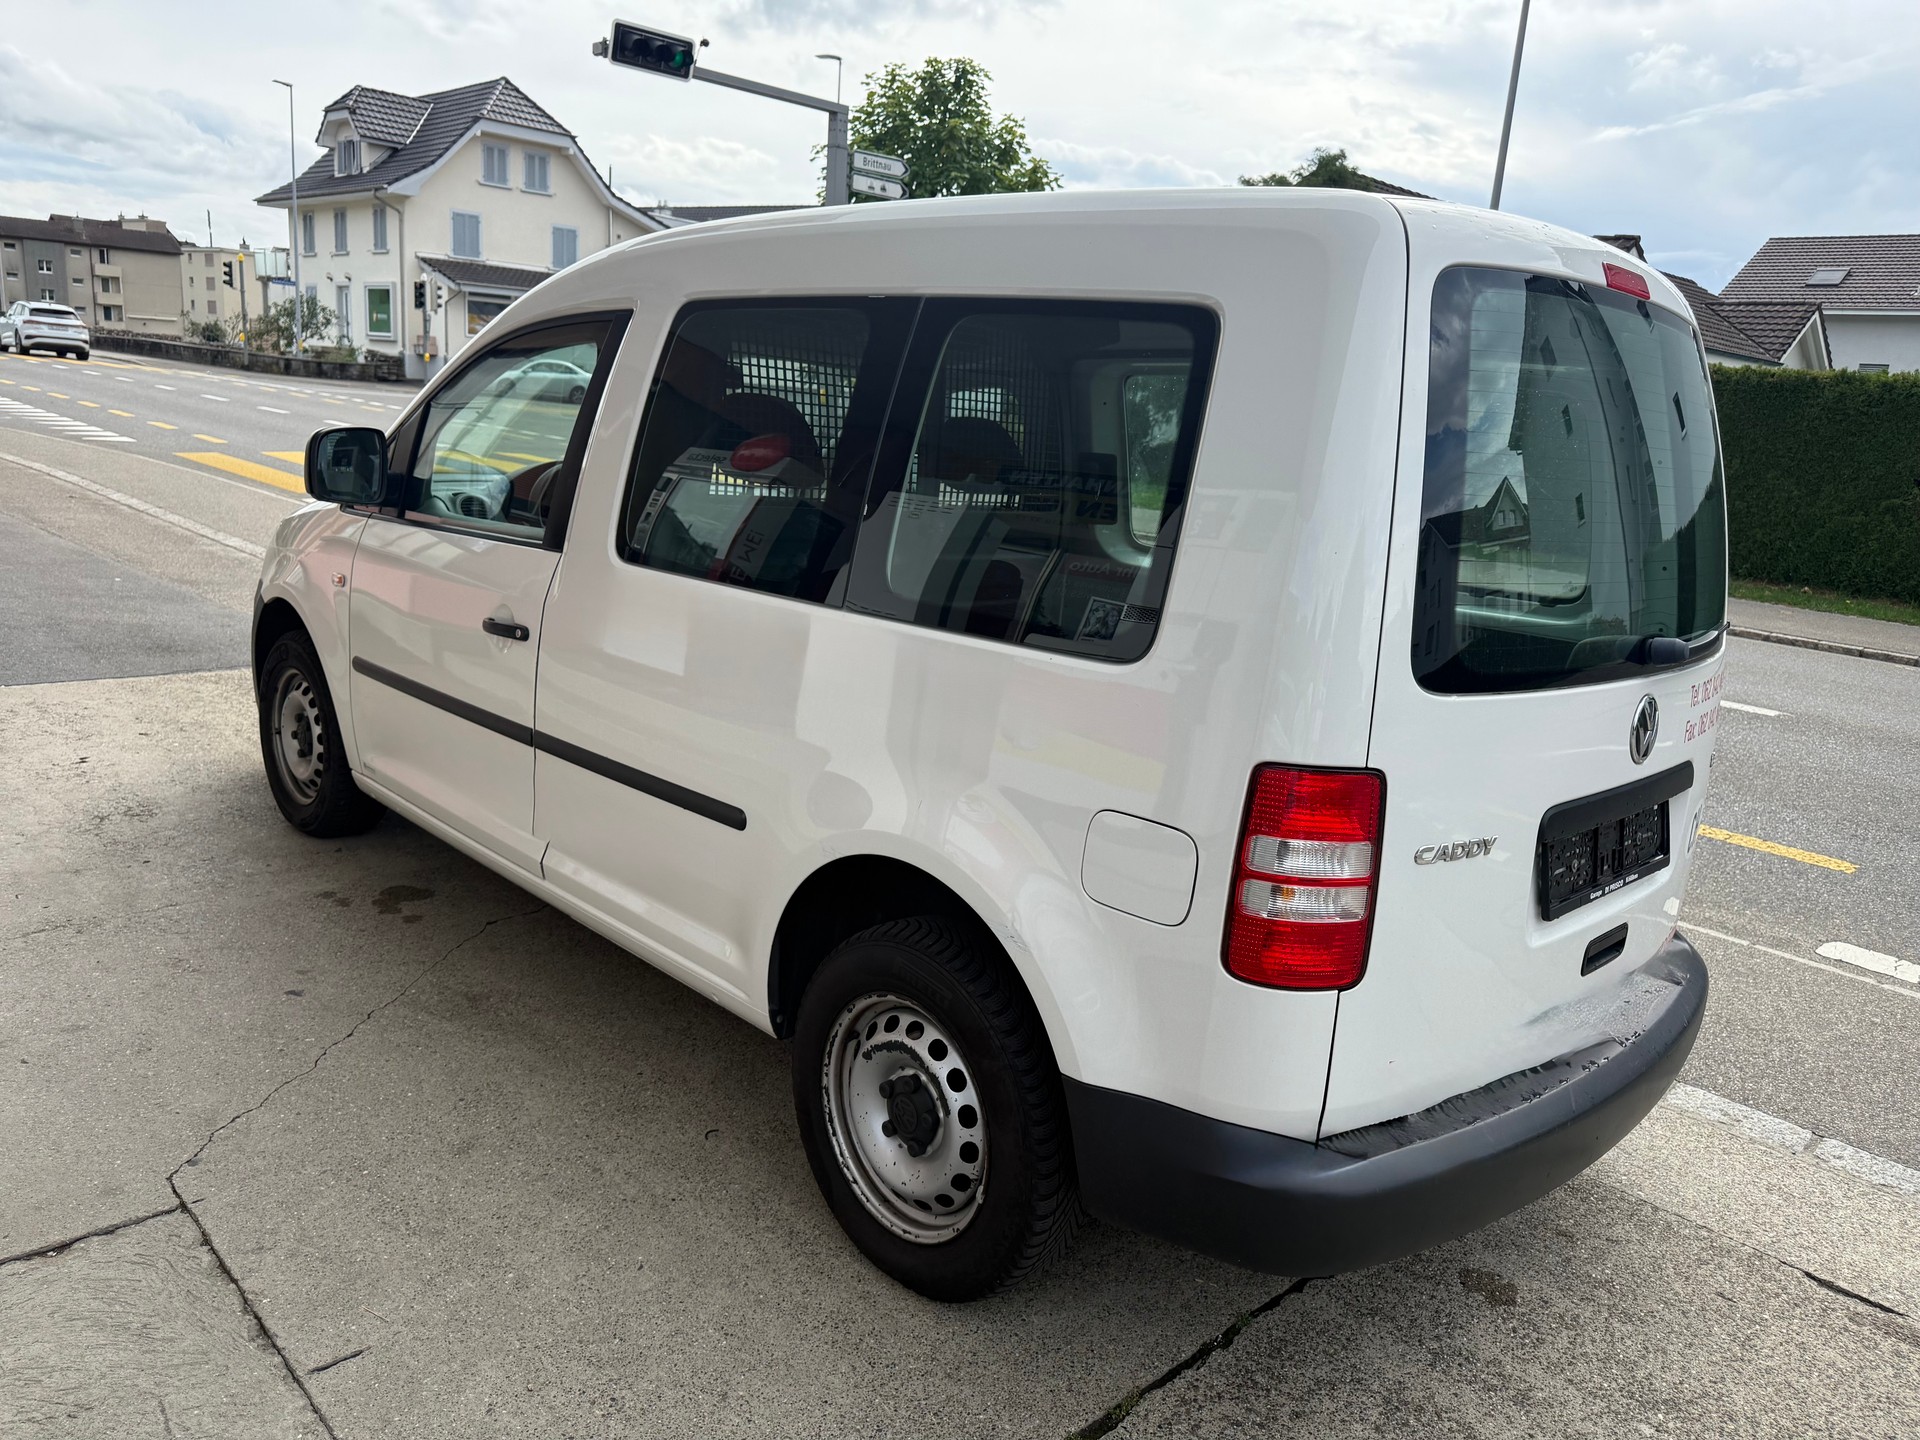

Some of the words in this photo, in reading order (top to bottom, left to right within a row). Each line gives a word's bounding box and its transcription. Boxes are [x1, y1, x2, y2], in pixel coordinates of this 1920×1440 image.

[863, 157, 892, 171] Brittnau
[1701, 678, 1713, 703] 062
[1413, 835, 1499, 866] CADDY
